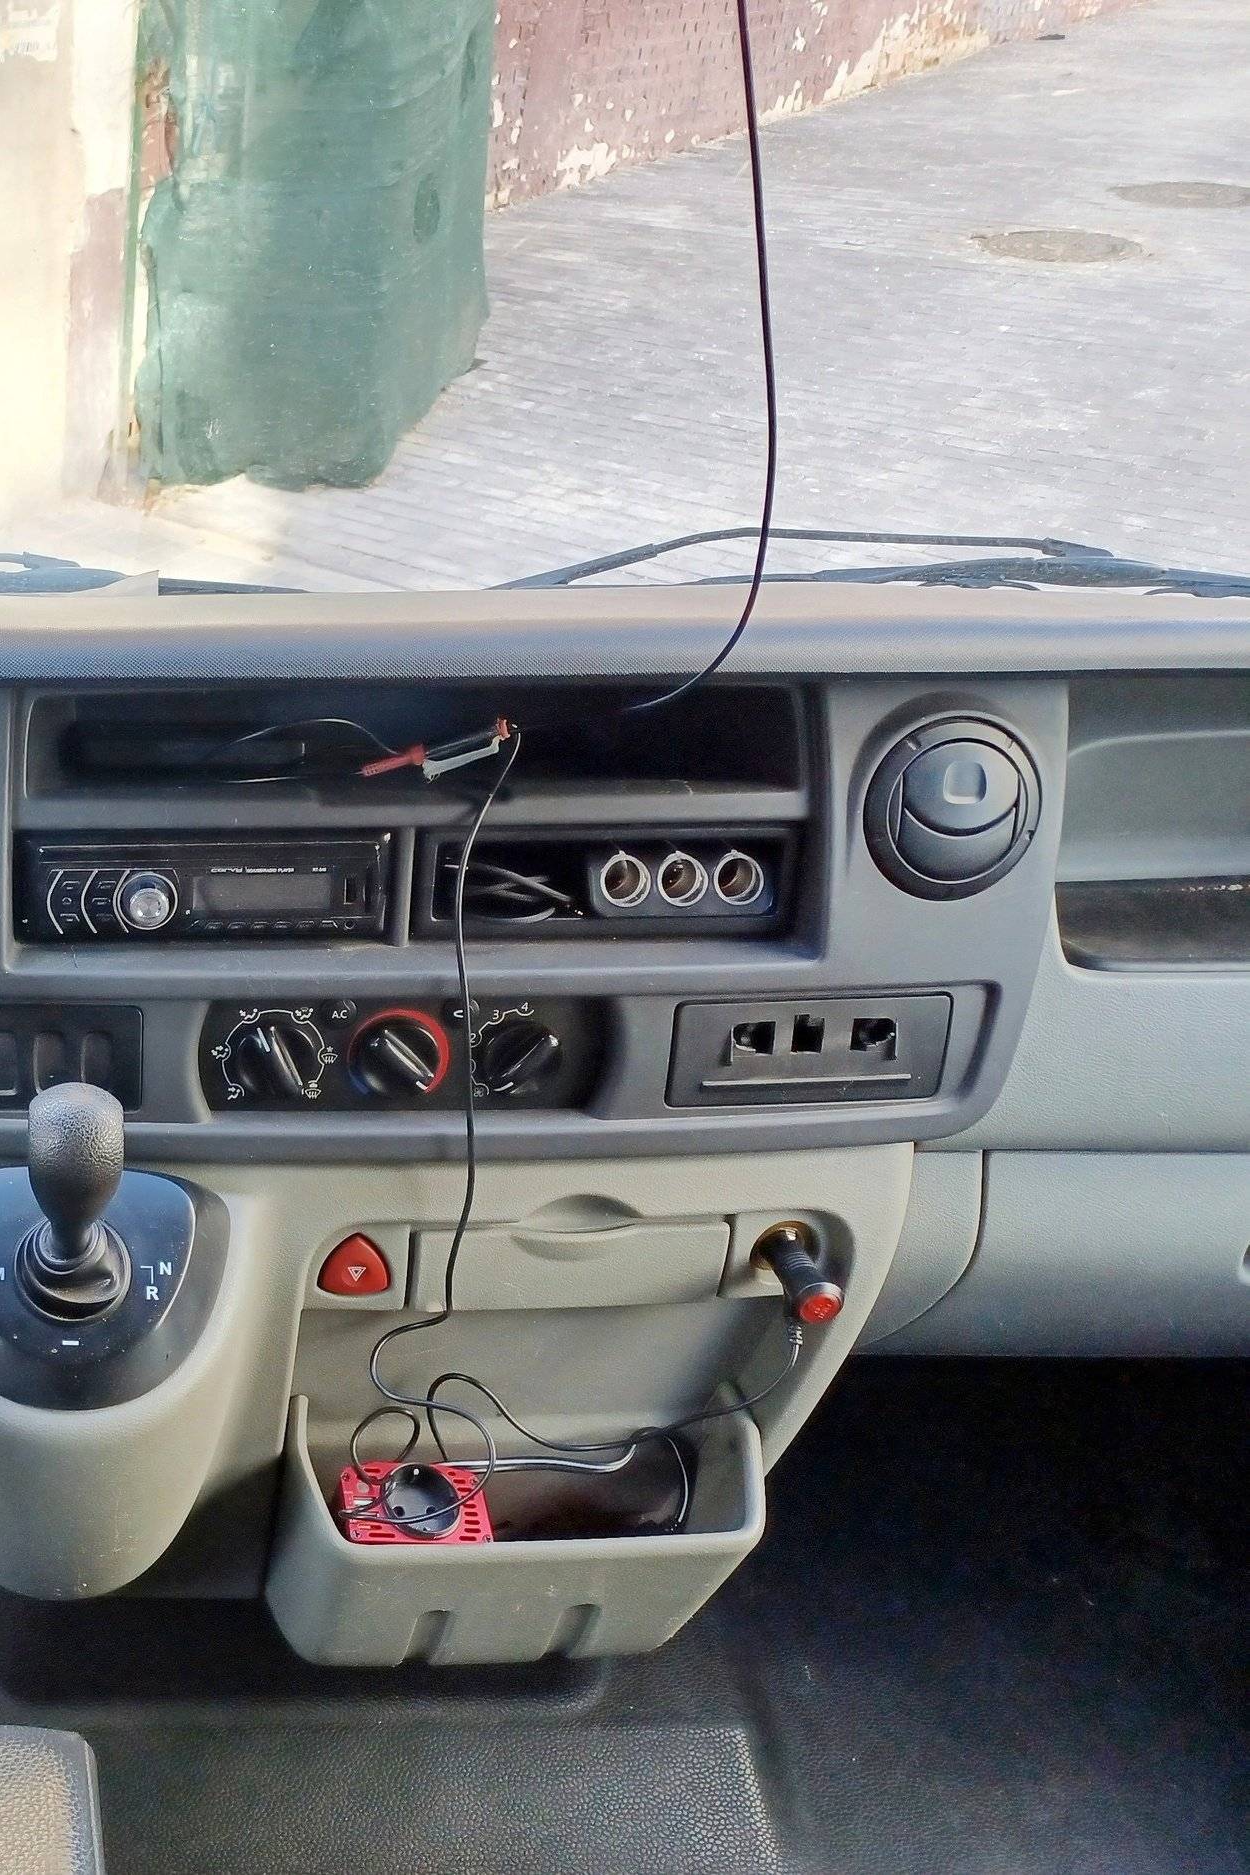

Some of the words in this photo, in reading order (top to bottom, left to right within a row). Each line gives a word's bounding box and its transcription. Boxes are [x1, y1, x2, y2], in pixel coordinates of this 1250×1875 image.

[520, 1002, 529, 1012] 4
[492, 1009, 500, 1020] 3
[470, 1032, 477, 1043] 2
[159, 1261, 172, 1276] N
[146, 1286, 160, 1301] R
